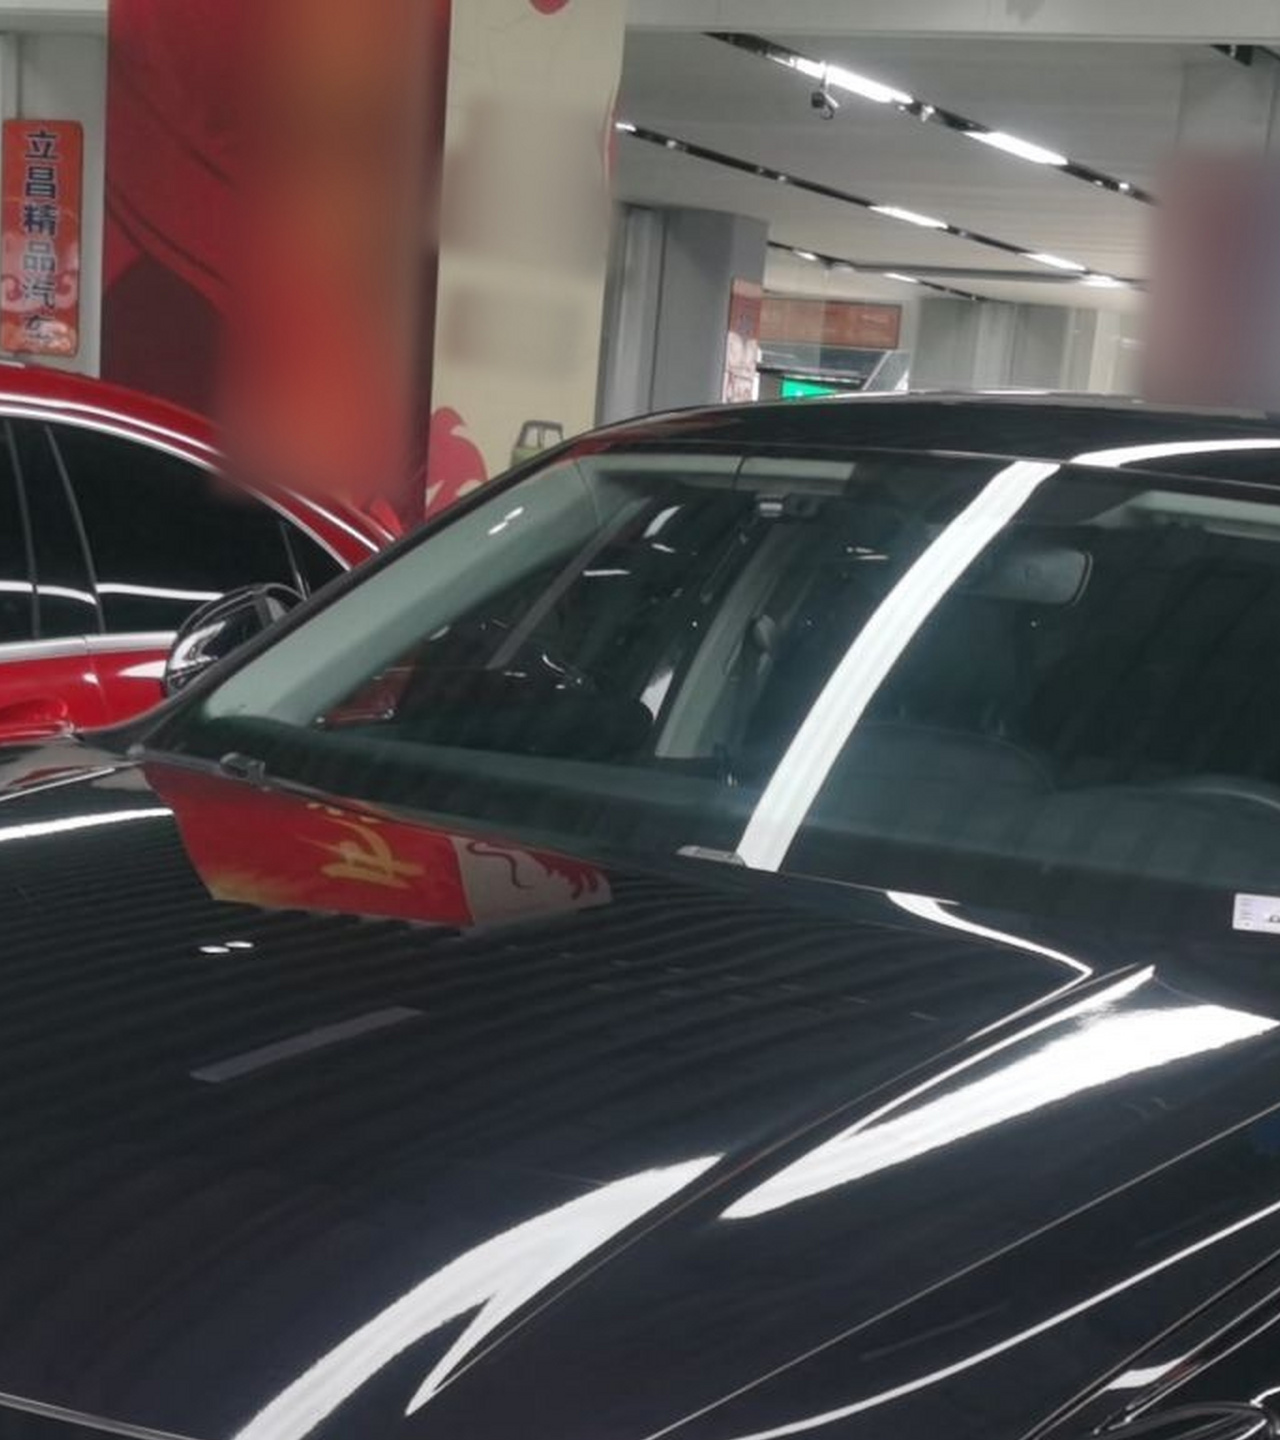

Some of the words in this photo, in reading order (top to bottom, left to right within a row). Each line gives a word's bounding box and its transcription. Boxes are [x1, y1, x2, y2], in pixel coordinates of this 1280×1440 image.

[21, 128, 59, 347] 立昌精品汽车
